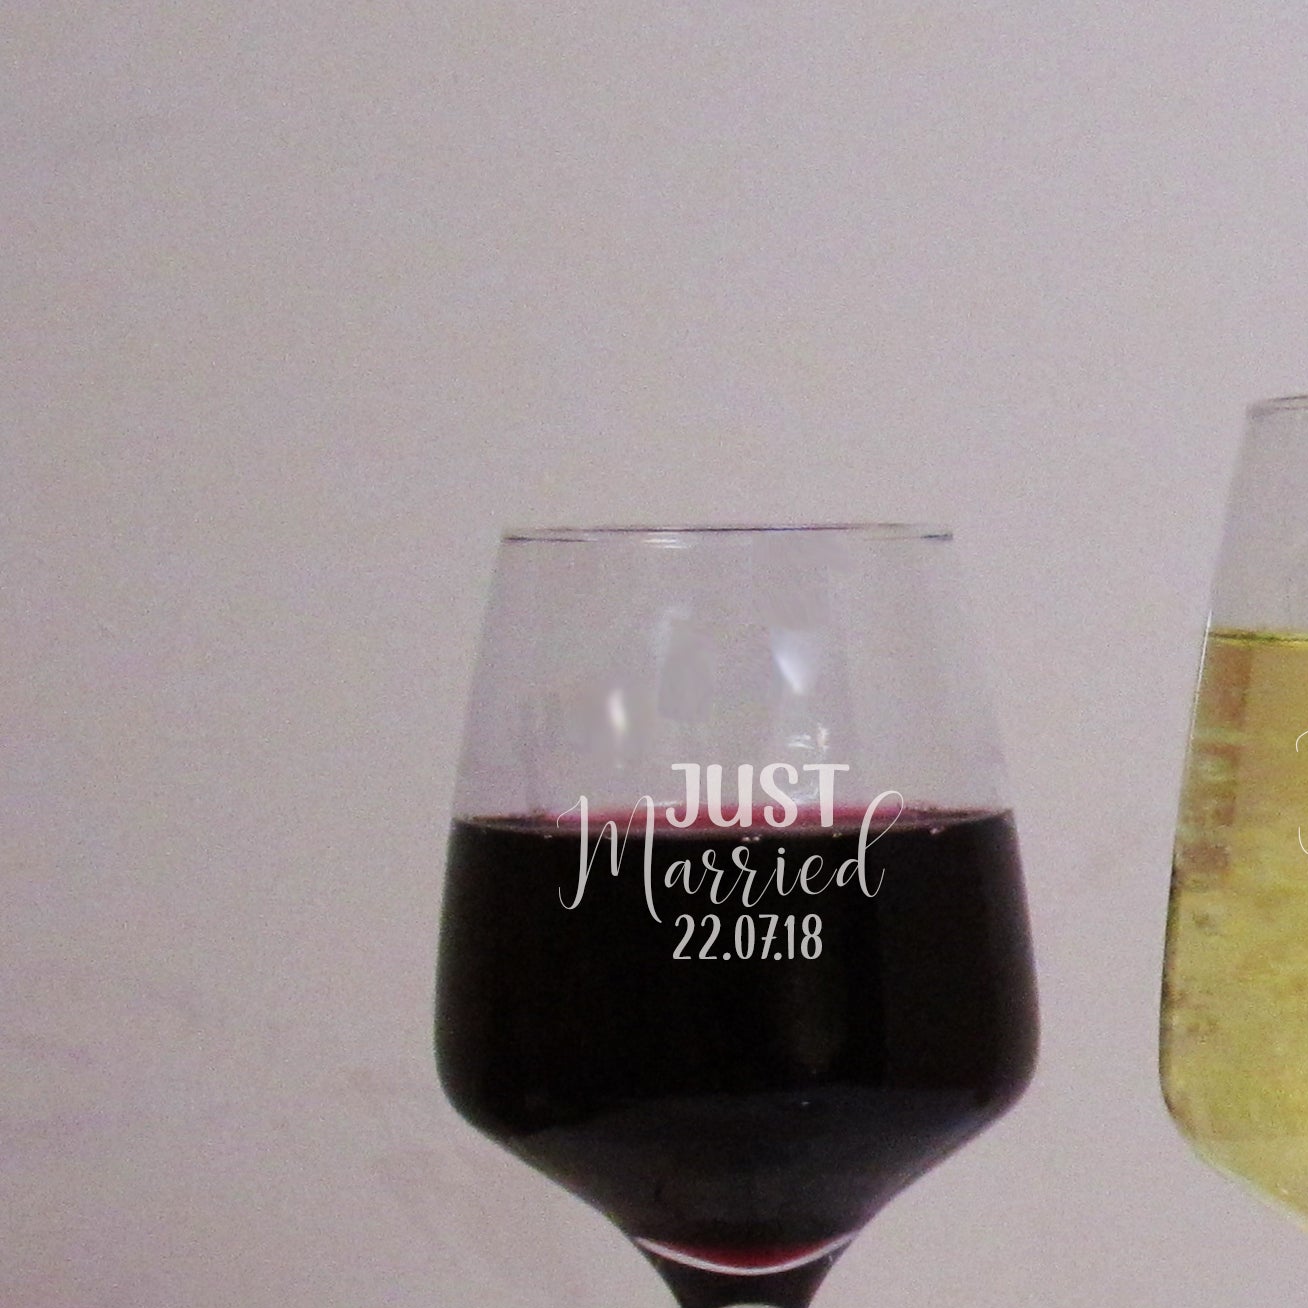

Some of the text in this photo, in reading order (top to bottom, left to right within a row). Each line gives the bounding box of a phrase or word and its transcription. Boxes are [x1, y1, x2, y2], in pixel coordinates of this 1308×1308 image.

[665, 762, 850, 828] JUST
[556, 790, 904, 924] Married
[672, 913, 823, 961] 22.07.18
